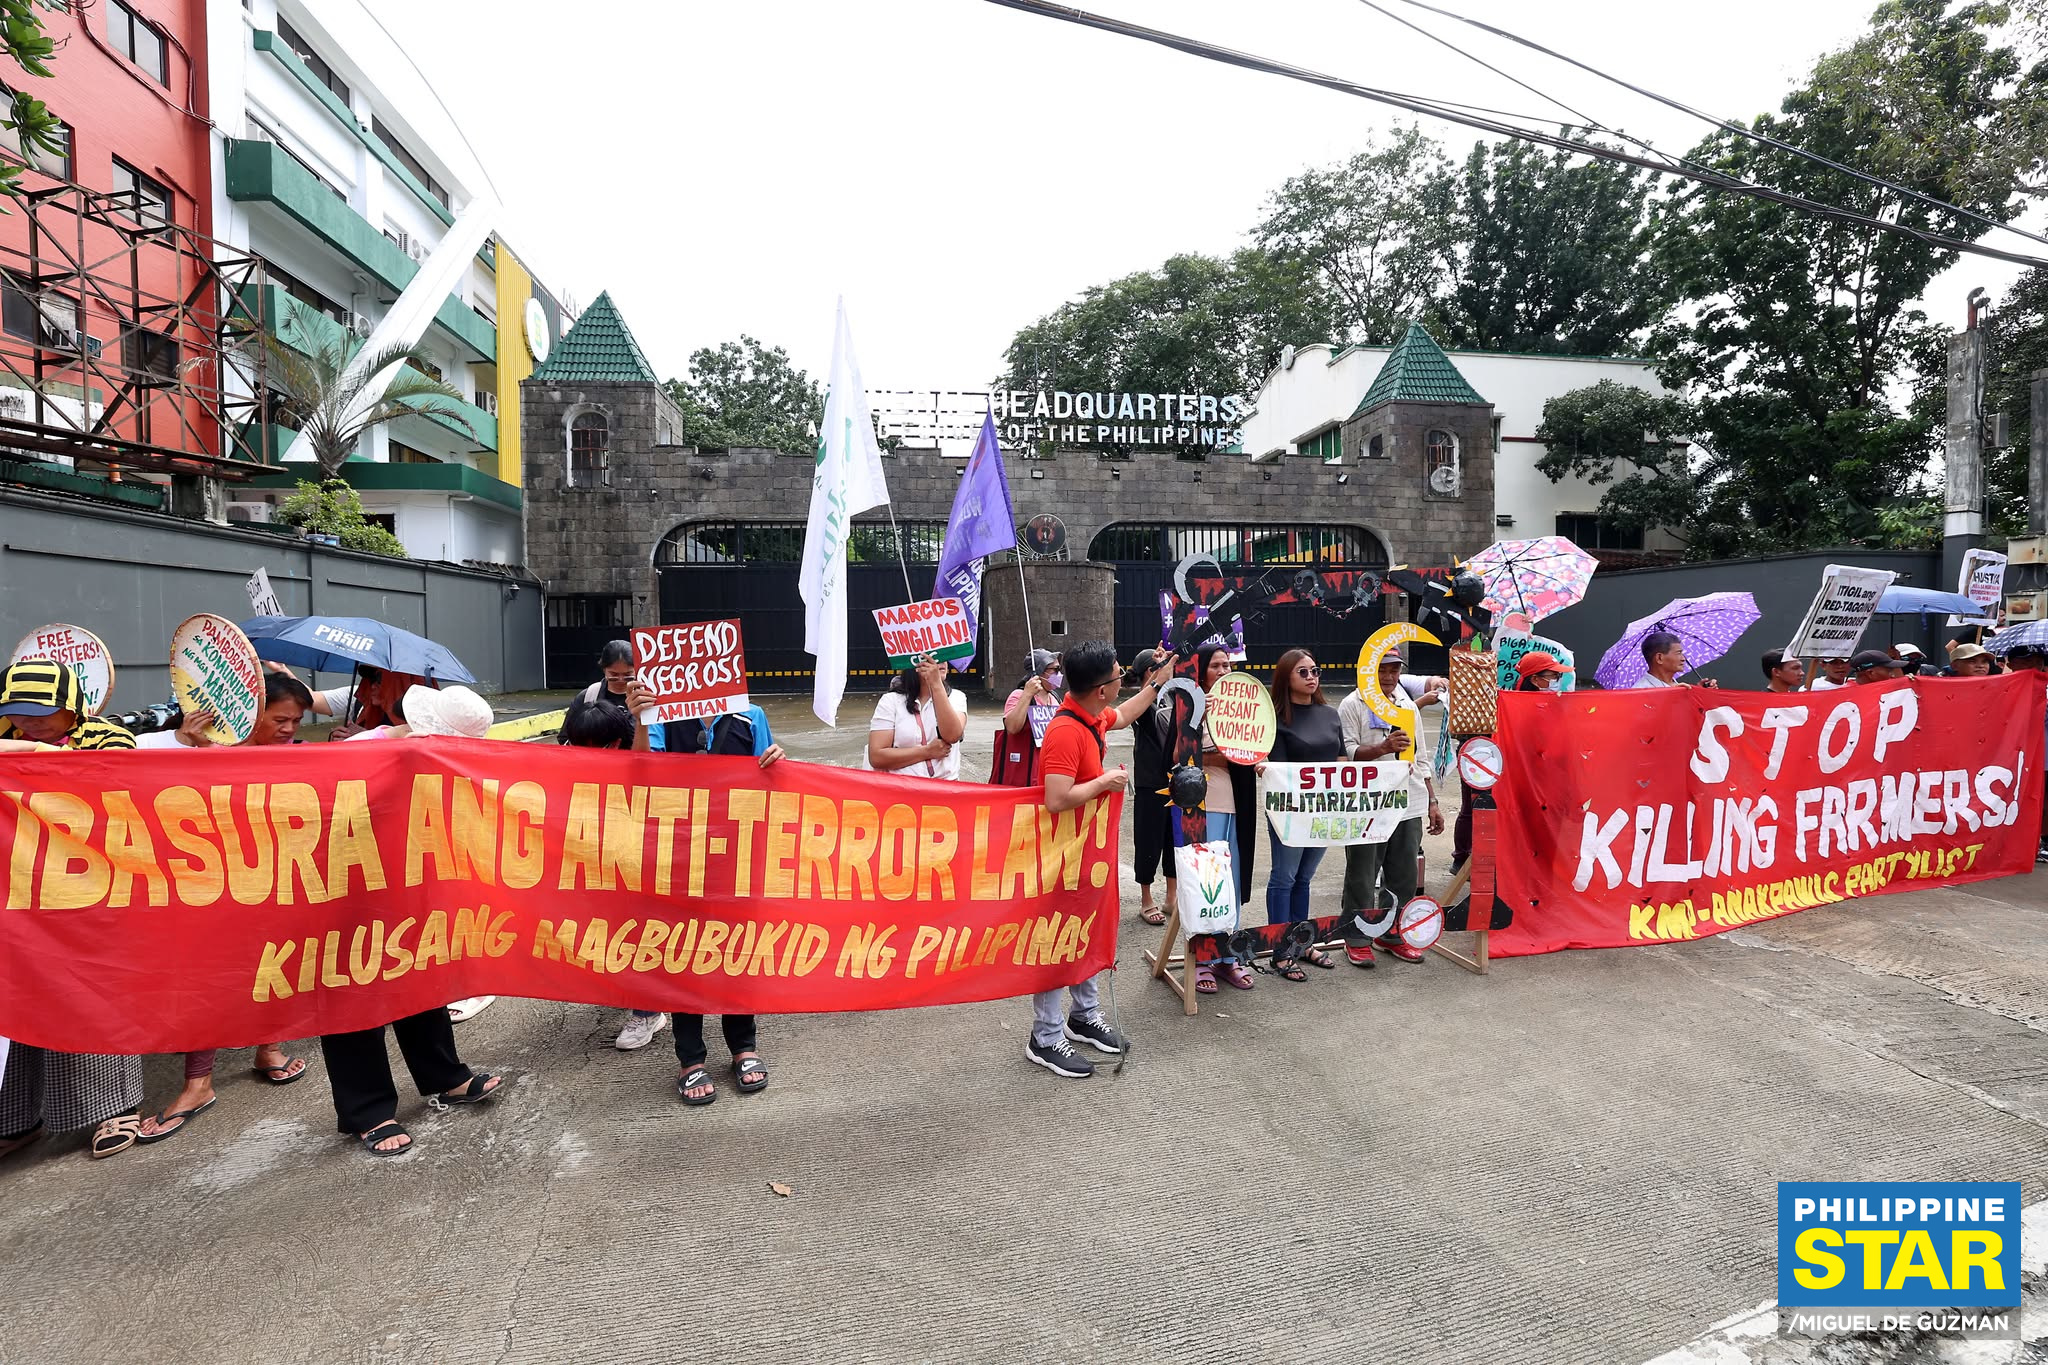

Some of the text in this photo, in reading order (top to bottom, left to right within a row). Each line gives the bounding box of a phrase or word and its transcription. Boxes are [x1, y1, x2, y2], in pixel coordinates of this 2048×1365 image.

[990, 390, 1237, 422] HEADQUARTERS
[1007, 424, 1244, 446] OF THE PHILIPPINES
[1837, 585, 1877, 601] ITIGIL ang
[878, 599, 960, 627] MARCOS
[1822, 600, 1874, 613] RED-TAGGING
[1815, 615, 1868, 627] at TERRORIST
[37, 629, 74, 650] FREE
[635, 621, 738, 664] DEFEND
[882, 619, 970, 655] SINGILIN!
[1811, 629, 1858, 640] LABELLING!
[50, 641, 100, 664] SISTERS!
[193, 635, 255, 711] SA KOMUNIDAD
[637, 655, 742, 696] NEGROS!
[182, 647, 252, 741] NG MGA MAGSASAKA
[1220, 680, 1259, 700] DEFEND
[657, 698, 728, 722] AMIHAN
[1211, 698, 1260, 721] PEASANT
[1216, 720, 1265, 744] WOMEN!
[1689, 687, 1920, 784] STOP
[1300, 766, 1378, 789] STOP
[1265, 790, 1408, 813] MILITARIZATION
[1310, 817, 1374, 839] NOW!
[1571, 751, 2025, 892] KILLING FARMERS!
[3, 774, 1110, 910] IBASURA ANG ANTI-TERROR LAW!
[1844, 843, 1984, 898] PARTYLIST
[1200, 905, 1229, 918] BIGAS
[252, 904, 1098, 1004] KILUSANG MAGBUBUKID NG PILIPINAS
